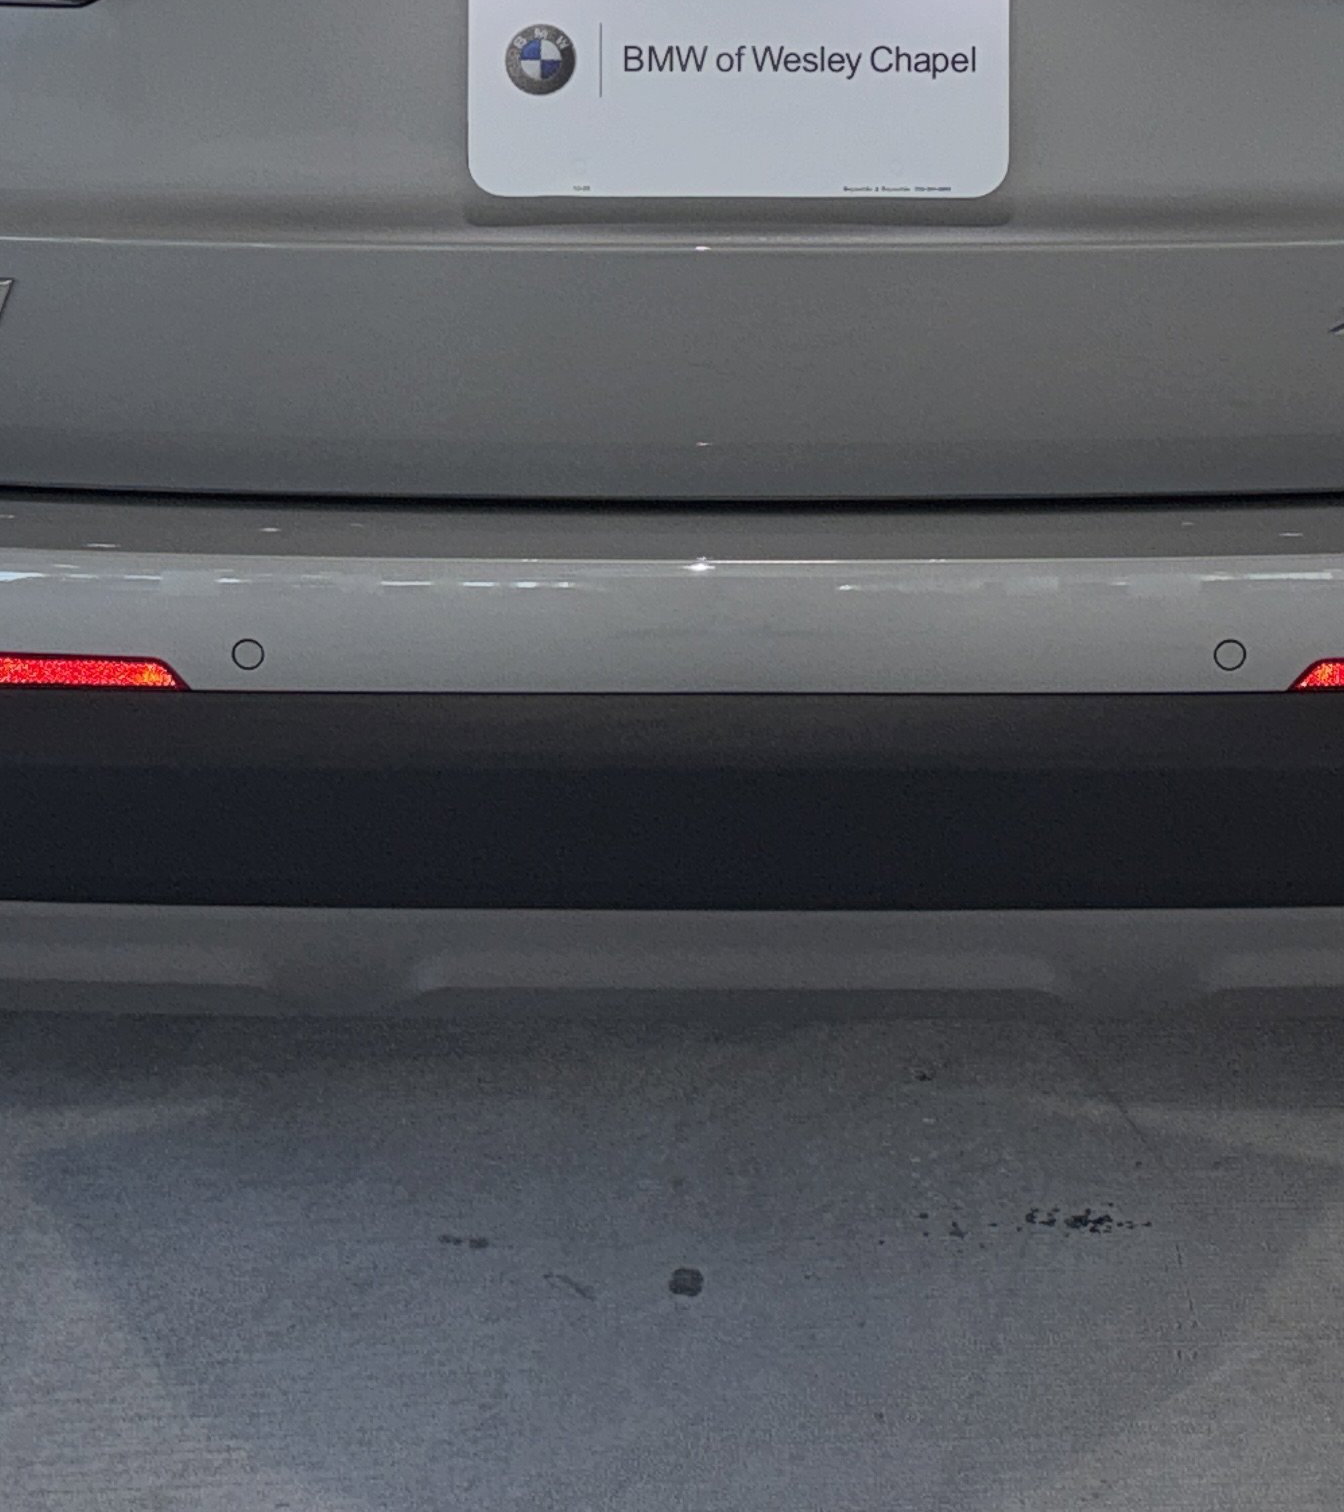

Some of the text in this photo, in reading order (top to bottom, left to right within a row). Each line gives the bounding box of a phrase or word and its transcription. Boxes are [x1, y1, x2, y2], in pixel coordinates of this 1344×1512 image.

[513, 27, 570, 50] BMW
[623, 45, 977, 80] BMW of Wesley Chapel
